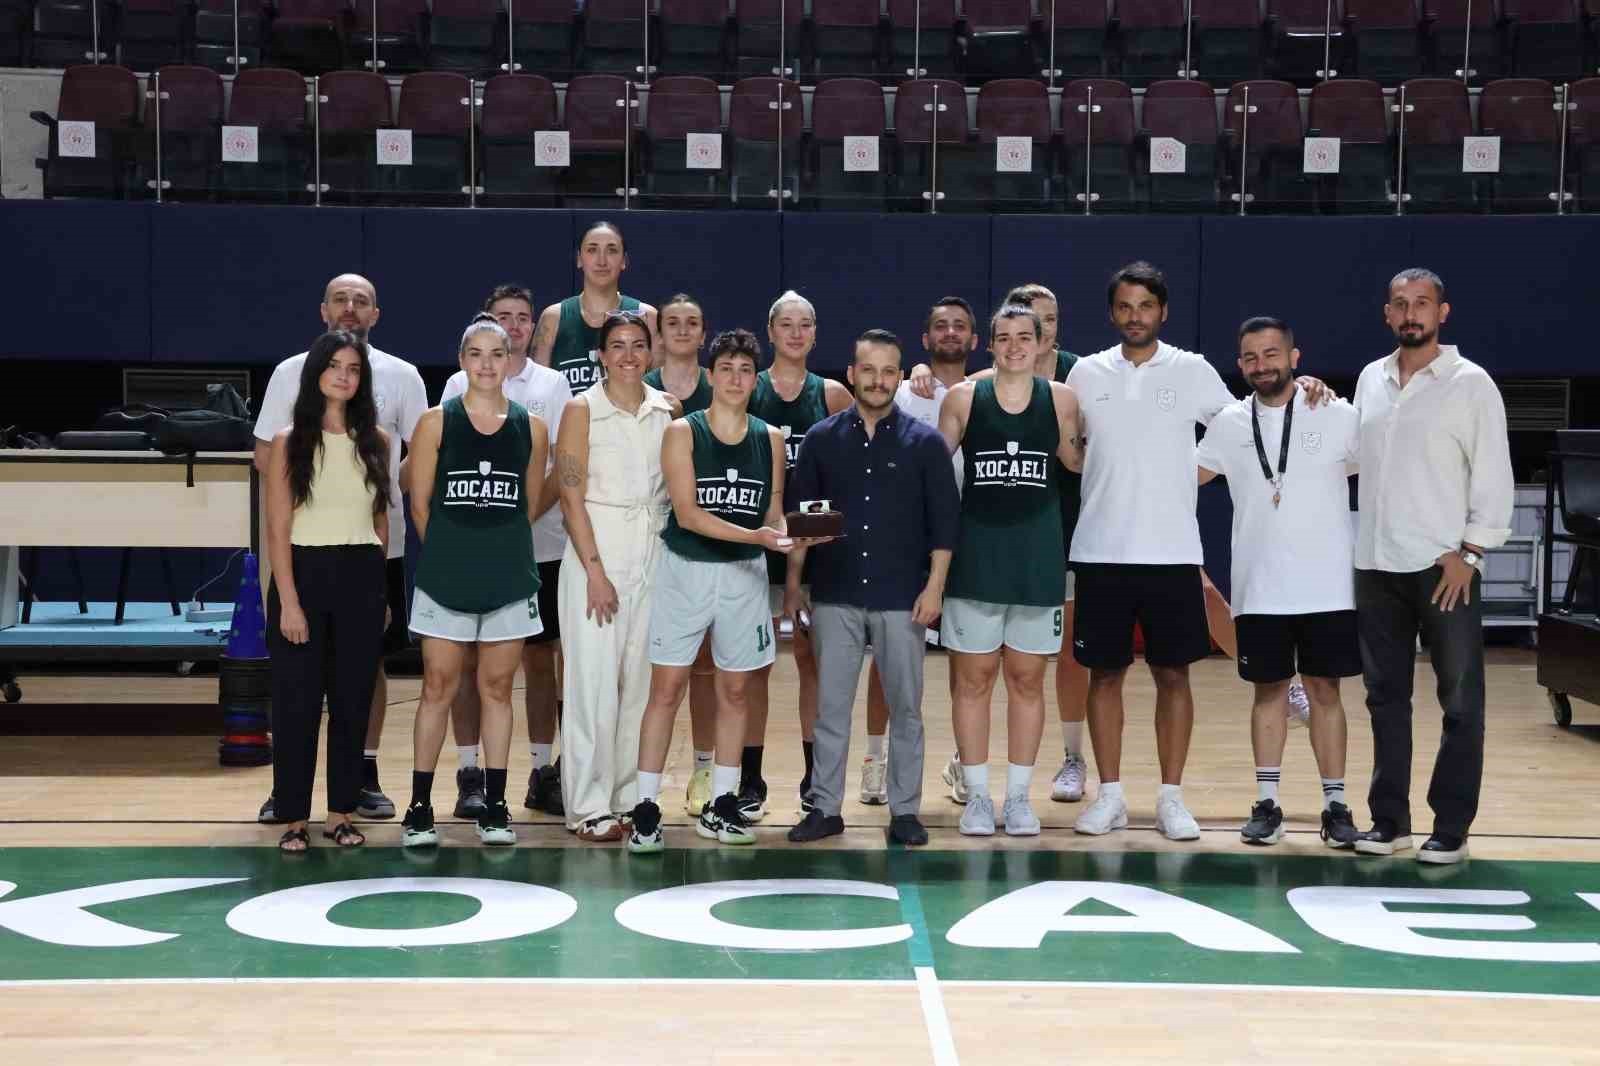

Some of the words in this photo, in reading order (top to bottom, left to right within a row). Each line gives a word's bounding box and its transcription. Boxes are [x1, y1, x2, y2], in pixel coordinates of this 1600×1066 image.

[974, 458, 1047, 480] KOCAELİ
[445, 479, 519, 501] KOCAELİ
[697, 486, 763, 509] KOCAELİ
[528, 600, 539, 620] 5
[1053, 609, 1062, 637] 9
[0, 876, 1600, 963] KOCAE
